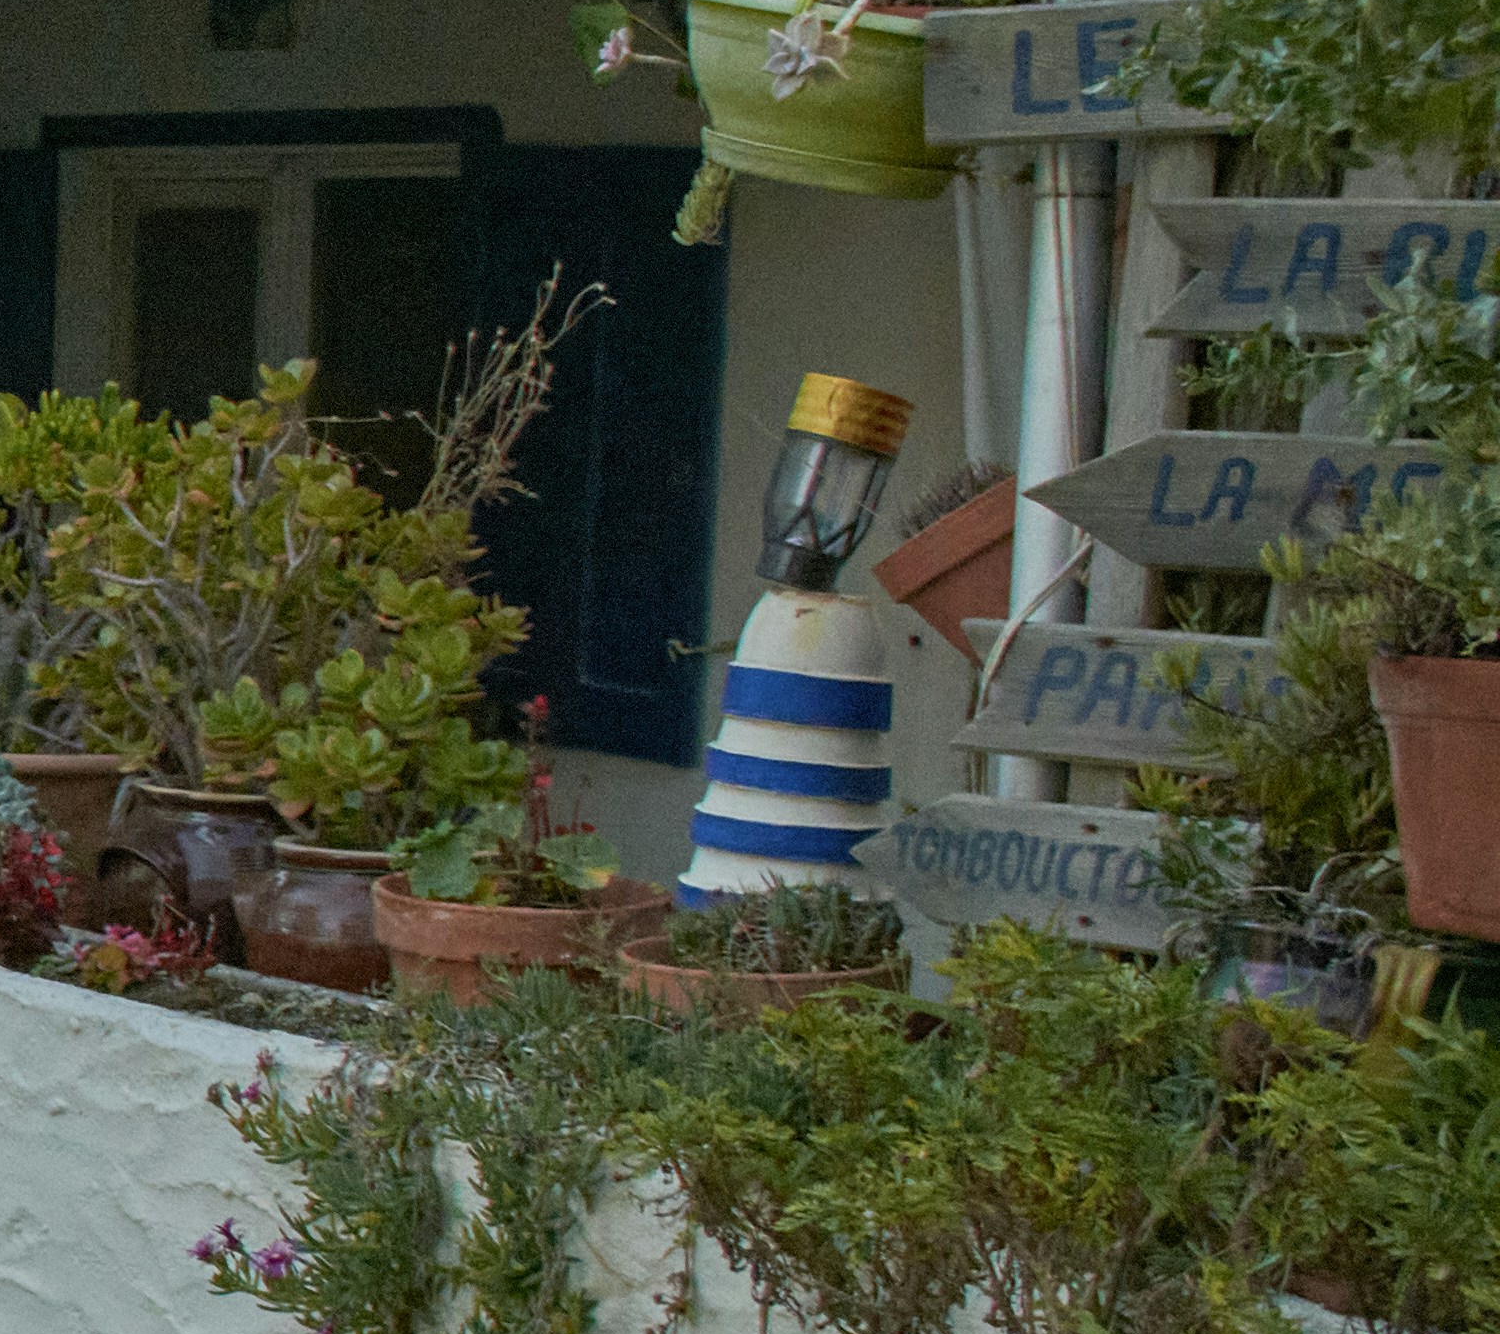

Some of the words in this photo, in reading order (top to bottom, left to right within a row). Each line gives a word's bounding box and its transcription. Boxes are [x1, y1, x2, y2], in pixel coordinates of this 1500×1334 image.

[1220, 221, 1341, 304] LA
[1150, 454, 1256, 526] LA
[891, 823, 1172, 908] TOMBOUCTO
